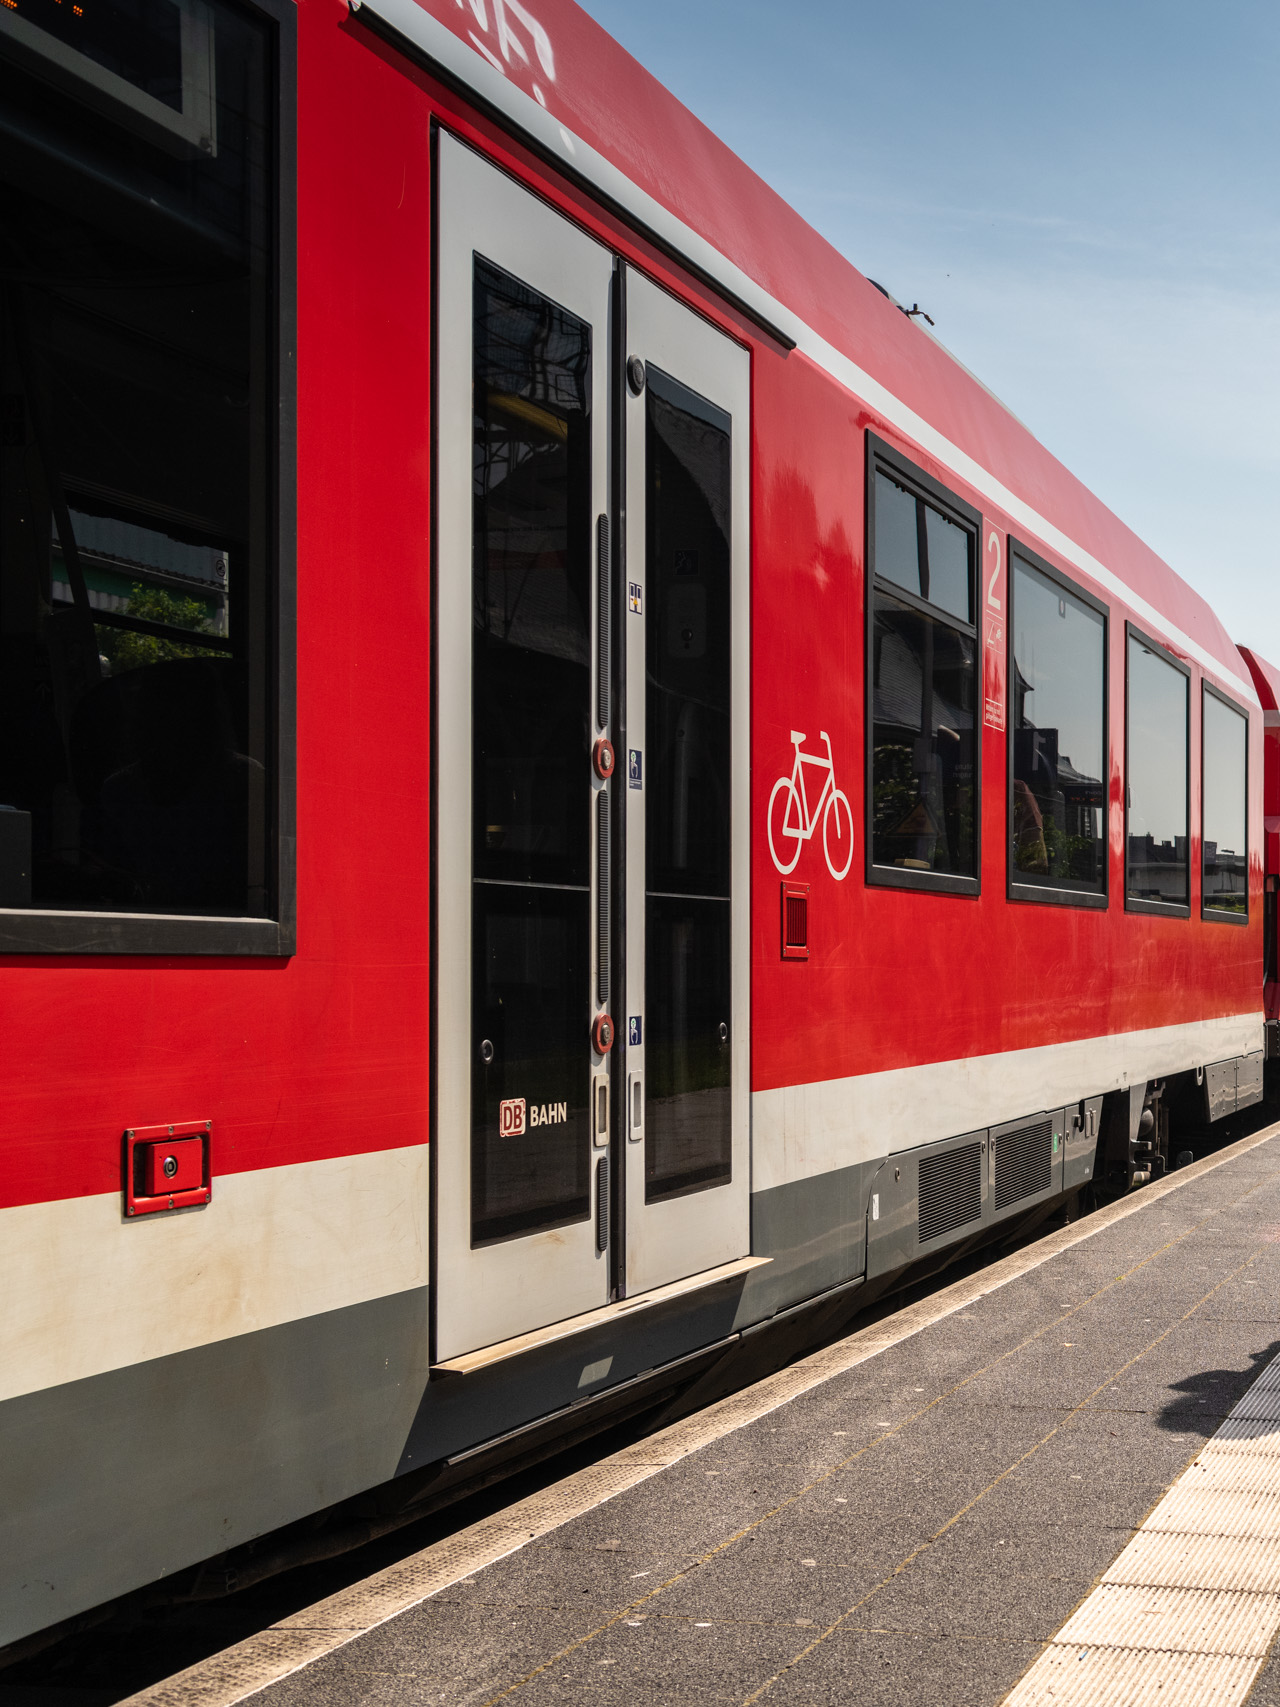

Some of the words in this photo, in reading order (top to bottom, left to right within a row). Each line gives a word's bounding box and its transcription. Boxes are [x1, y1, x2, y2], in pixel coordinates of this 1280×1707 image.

[988, 531, 1001, 611] 2
[502, 1103, 524, 1132] DB
[530, 1102, 567, 1127] BAHN
